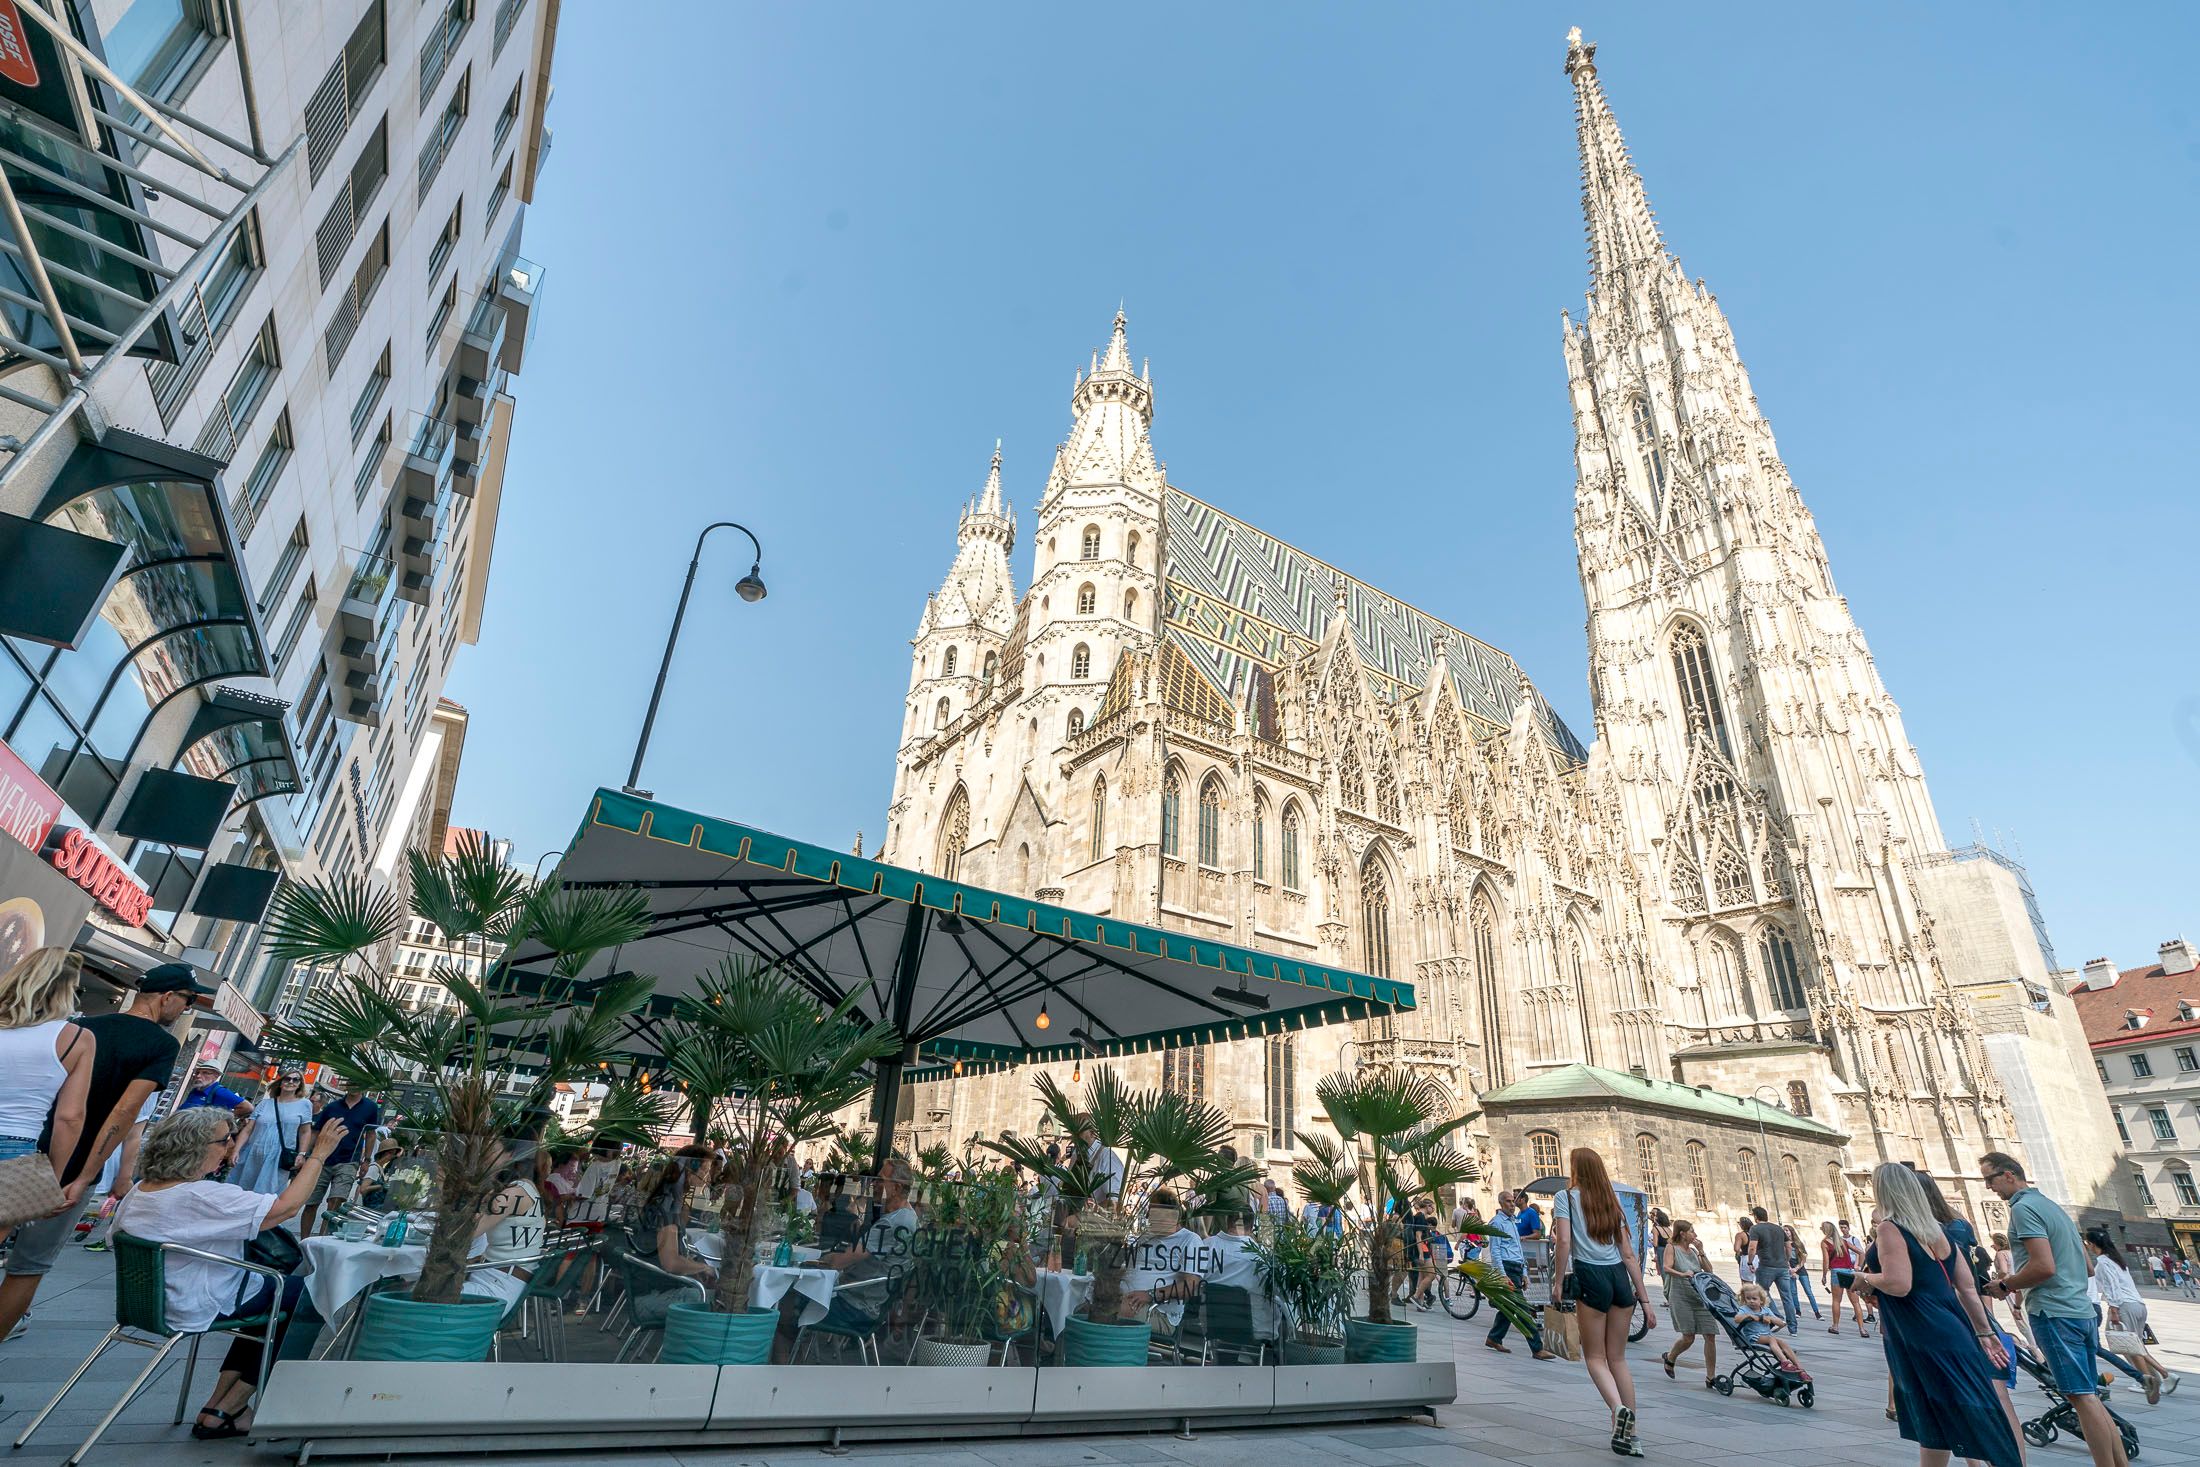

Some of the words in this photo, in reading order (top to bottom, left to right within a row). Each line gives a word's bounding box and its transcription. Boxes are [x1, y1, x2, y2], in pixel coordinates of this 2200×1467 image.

[0, 770, 50, 851] VENIRS
[54, 828, 154, 928] SOUVENIRS
[1109, 1242, 1224, 1274] ZWISCHEN
[1153, 1277, 1209, 1306] GANG
